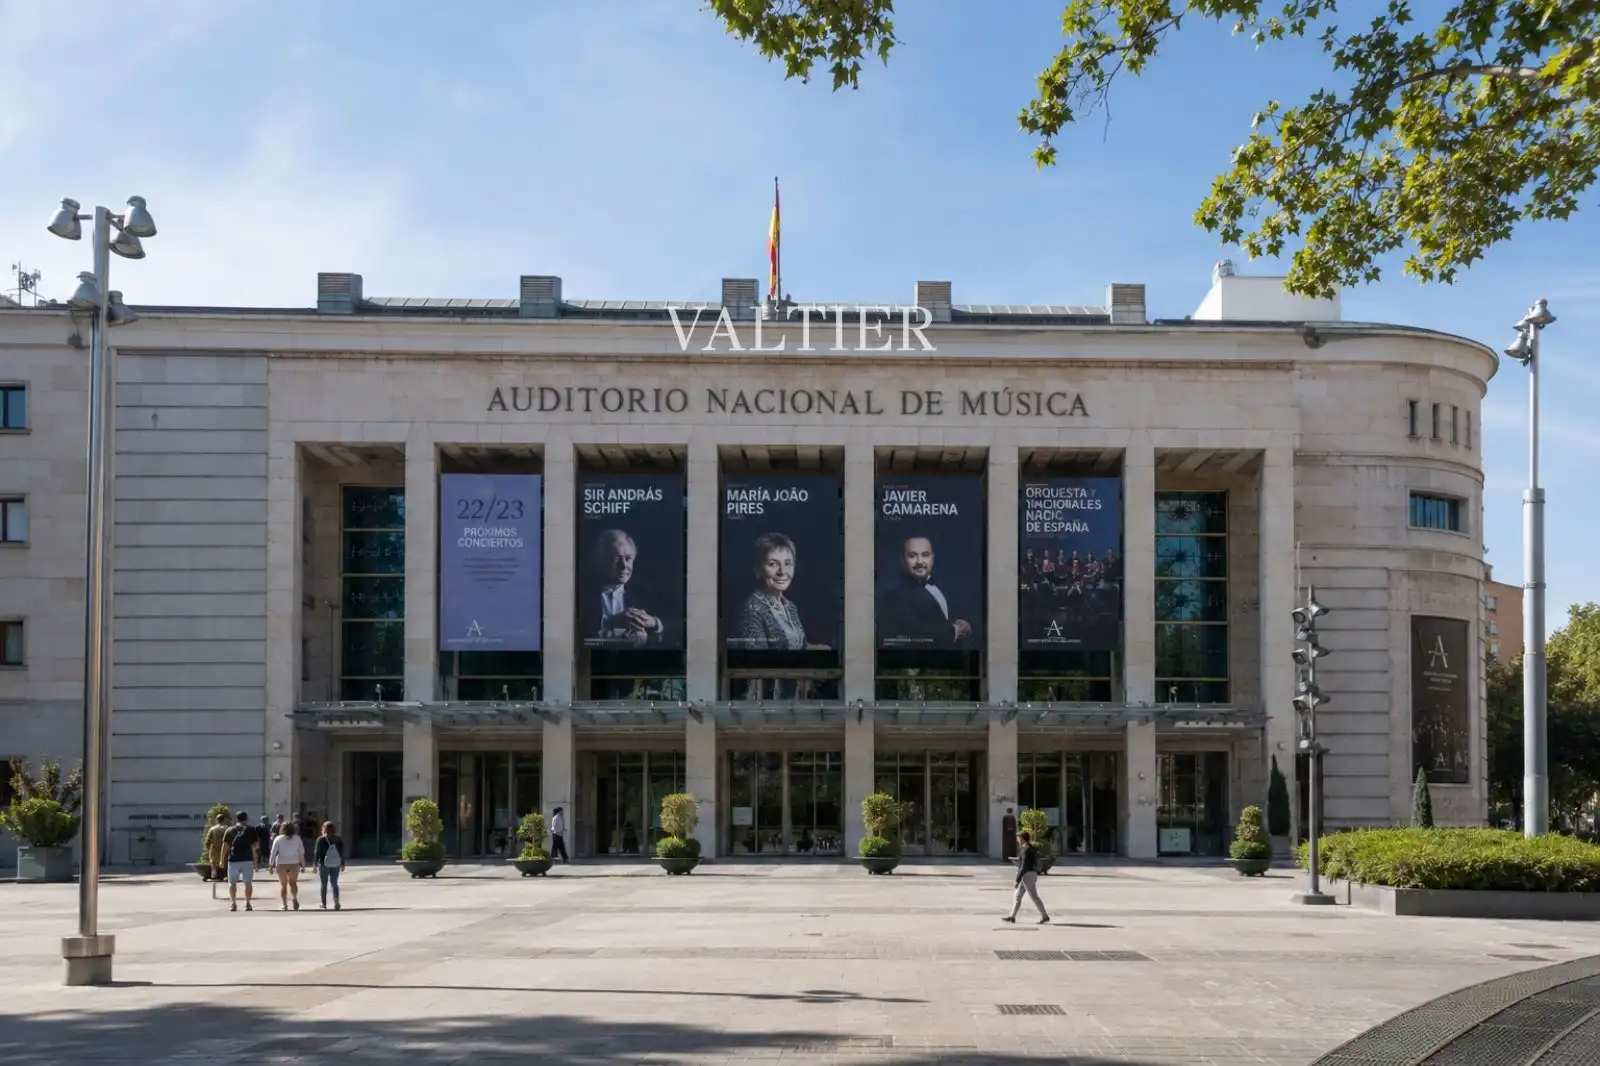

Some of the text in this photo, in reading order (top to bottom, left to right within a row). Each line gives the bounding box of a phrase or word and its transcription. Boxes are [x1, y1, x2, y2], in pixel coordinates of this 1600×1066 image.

[486, 386, 1090, 417] AUDITORIO NACIONAL DE MÚSICA
[584, 486, 663, 501] SIR ANDRÁS
[726, 487, 809, 502] MARÍA JOÃO
[882, 490, 927, 503] JAVIER
[1025, 487, 1088, 498] ORQUESTA
[456, 493, 525, 522] 22/23
[584, 502, 631, 514] SCHIFF
[726, 502, 765, 514] PIRES
[882, 503, 959, 516] CAMARENA
[1026, 519, 1090, 533] DE ESPAÑA
[457, 537, 525, 548] CONCIERTOS
